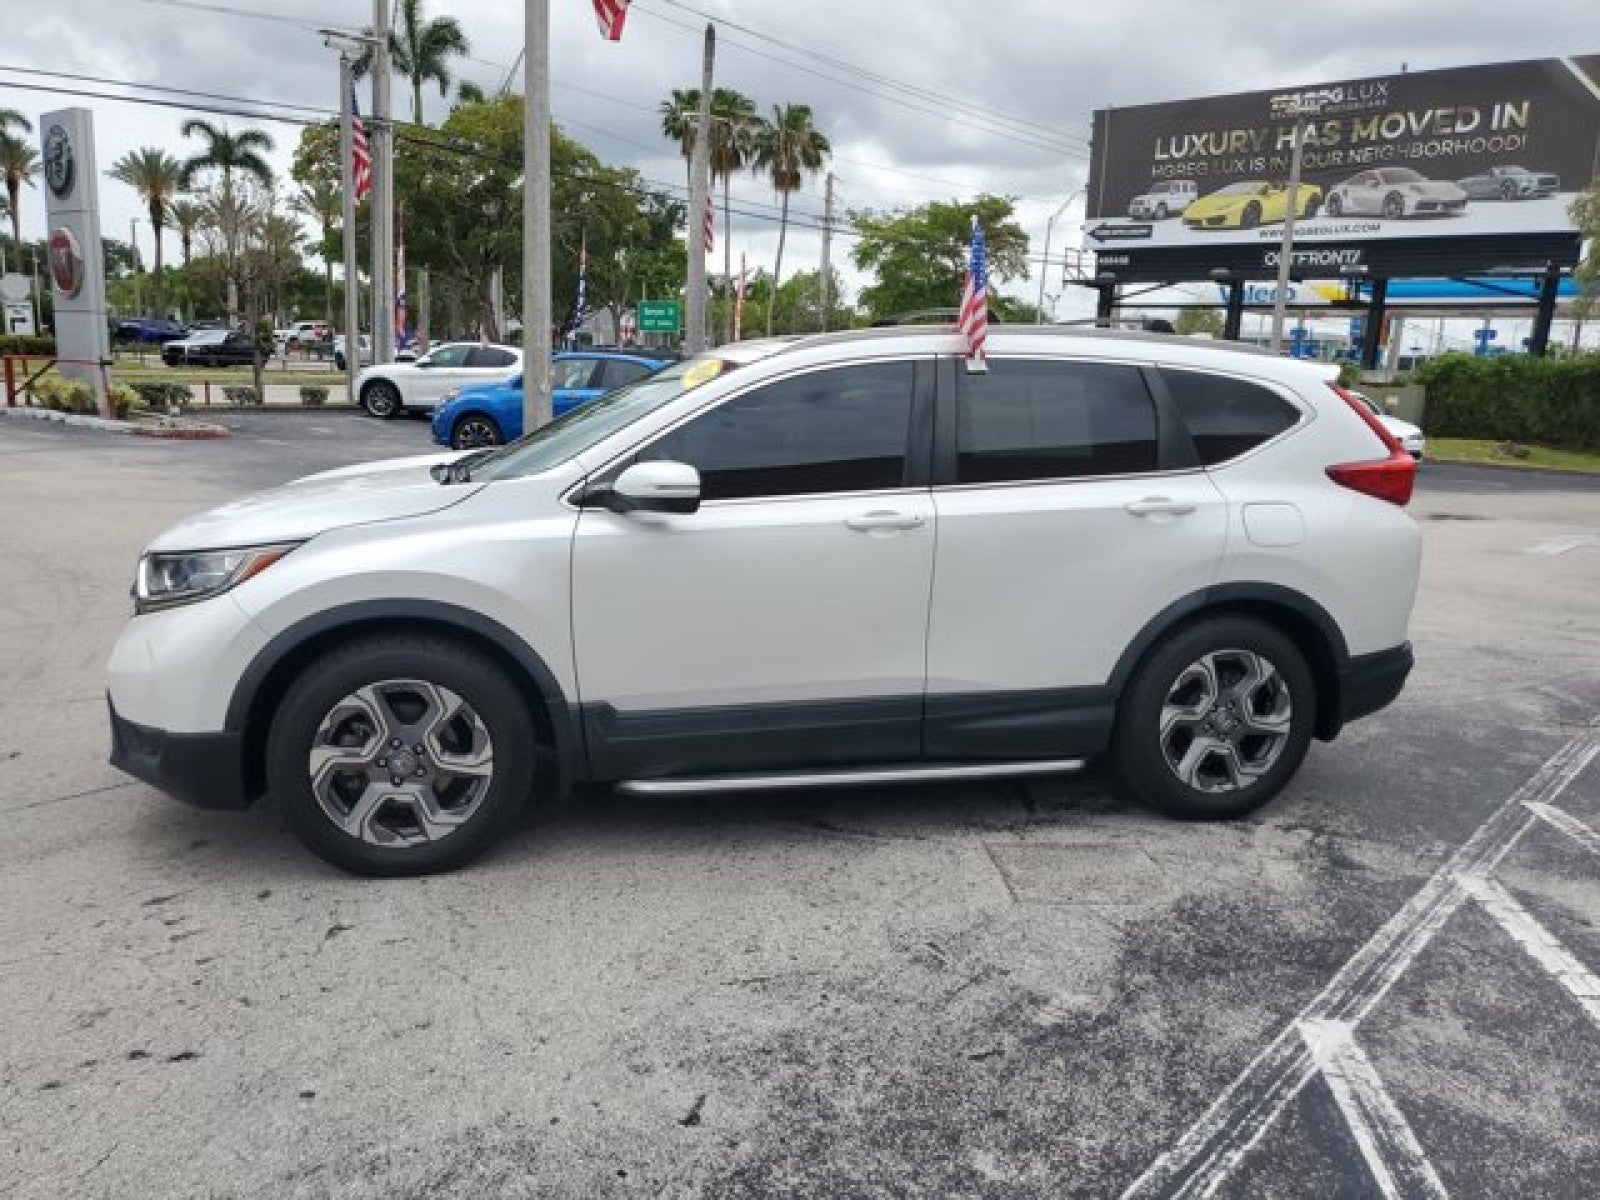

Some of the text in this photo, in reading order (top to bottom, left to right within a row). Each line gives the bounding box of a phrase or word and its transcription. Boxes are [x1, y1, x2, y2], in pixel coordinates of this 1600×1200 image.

[1154, 129, 1267, 160] LUXURY
[1277, 118, 1342, 150] HAS
[1352, 105, 1481, 143] MOVED
[1491, 101, 1531, 131] IN
[1250, 156, 1266, 172] IS
[1301, 151, 1343, 168] OUR
[1349, 134, 1526, 163] NEIGHBORHOOD!
